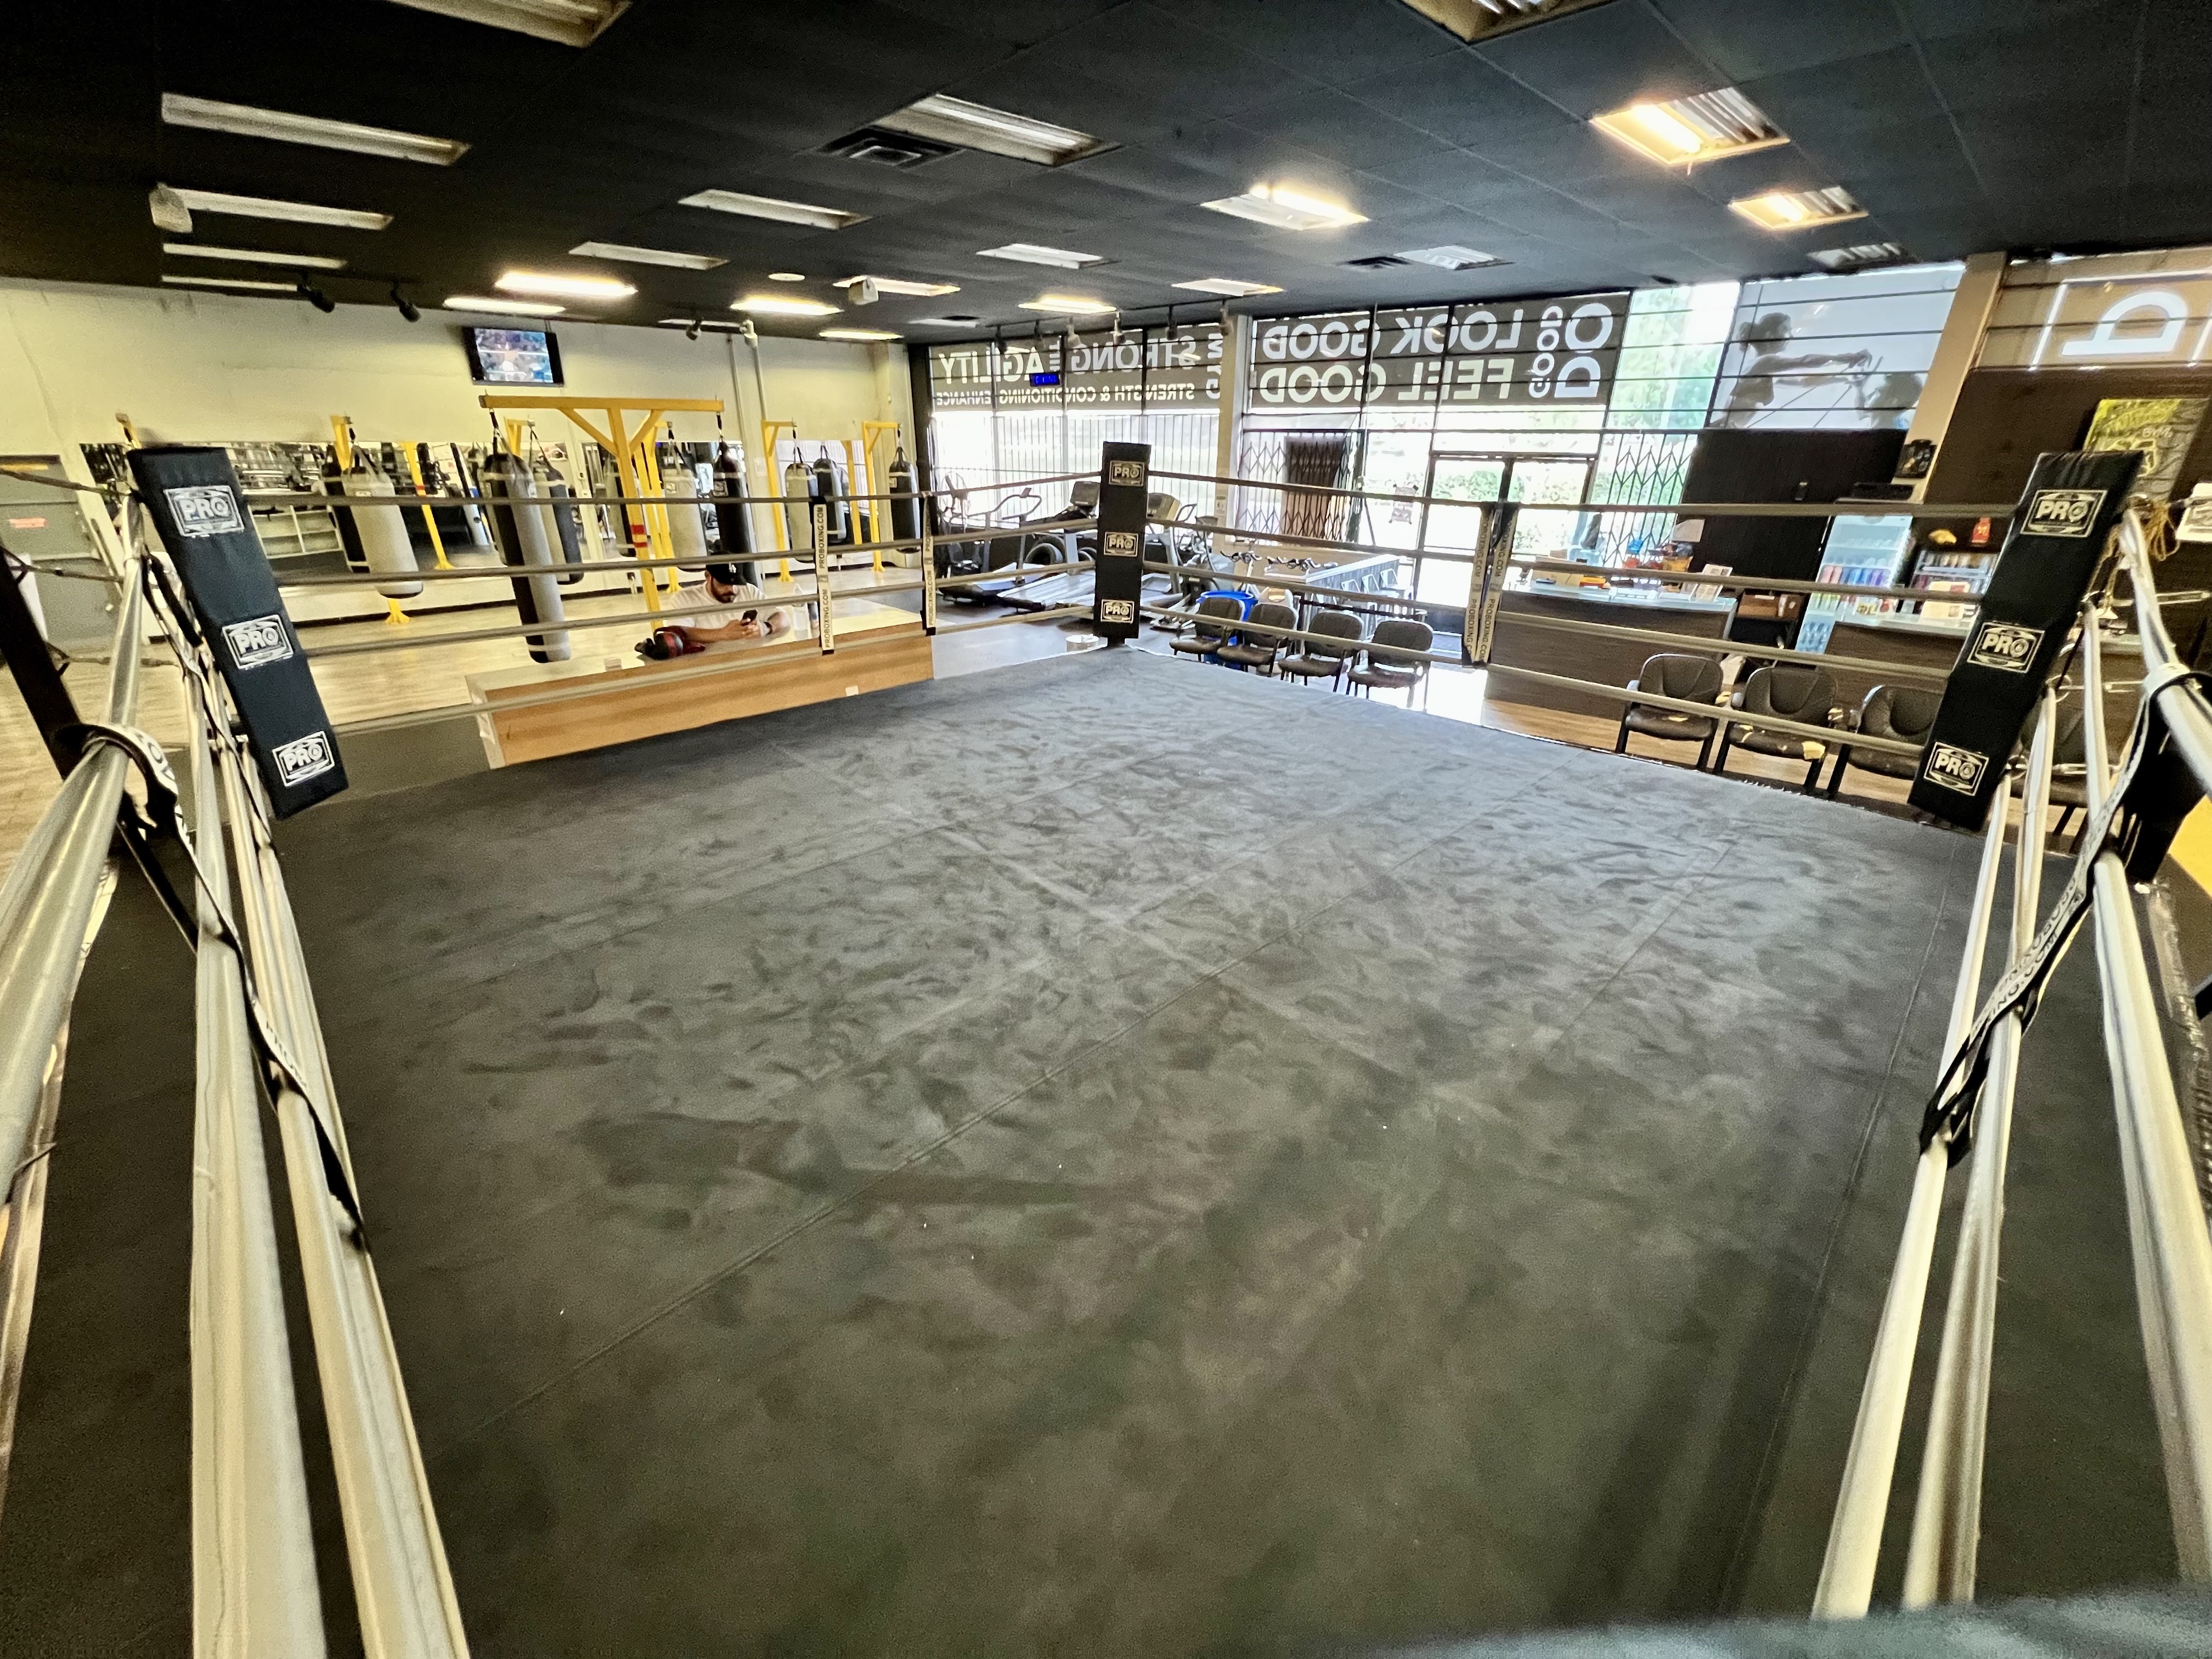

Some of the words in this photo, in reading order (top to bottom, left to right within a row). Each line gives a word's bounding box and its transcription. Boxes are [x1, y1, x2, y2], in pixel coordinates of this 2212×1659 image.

[1114, 466, 1139, 478] PRO
[179, 496, 229, 521] PRO
[2035, 500, 2089, 522] PRO
[1108, 538, 1133, 548] PRO
[927, 571, 935, 625] PROBOXING.COM
[1105, 605, 1129, 616] PRO
[821, 589, 831, 648] PROBOXING.COM
[236, 627, 280, 656] PRO
[1982, 633, 2030, 657] PRO
[284, 746, 324, 772] PRO
[1934, 755, 1976, 780] PRO
